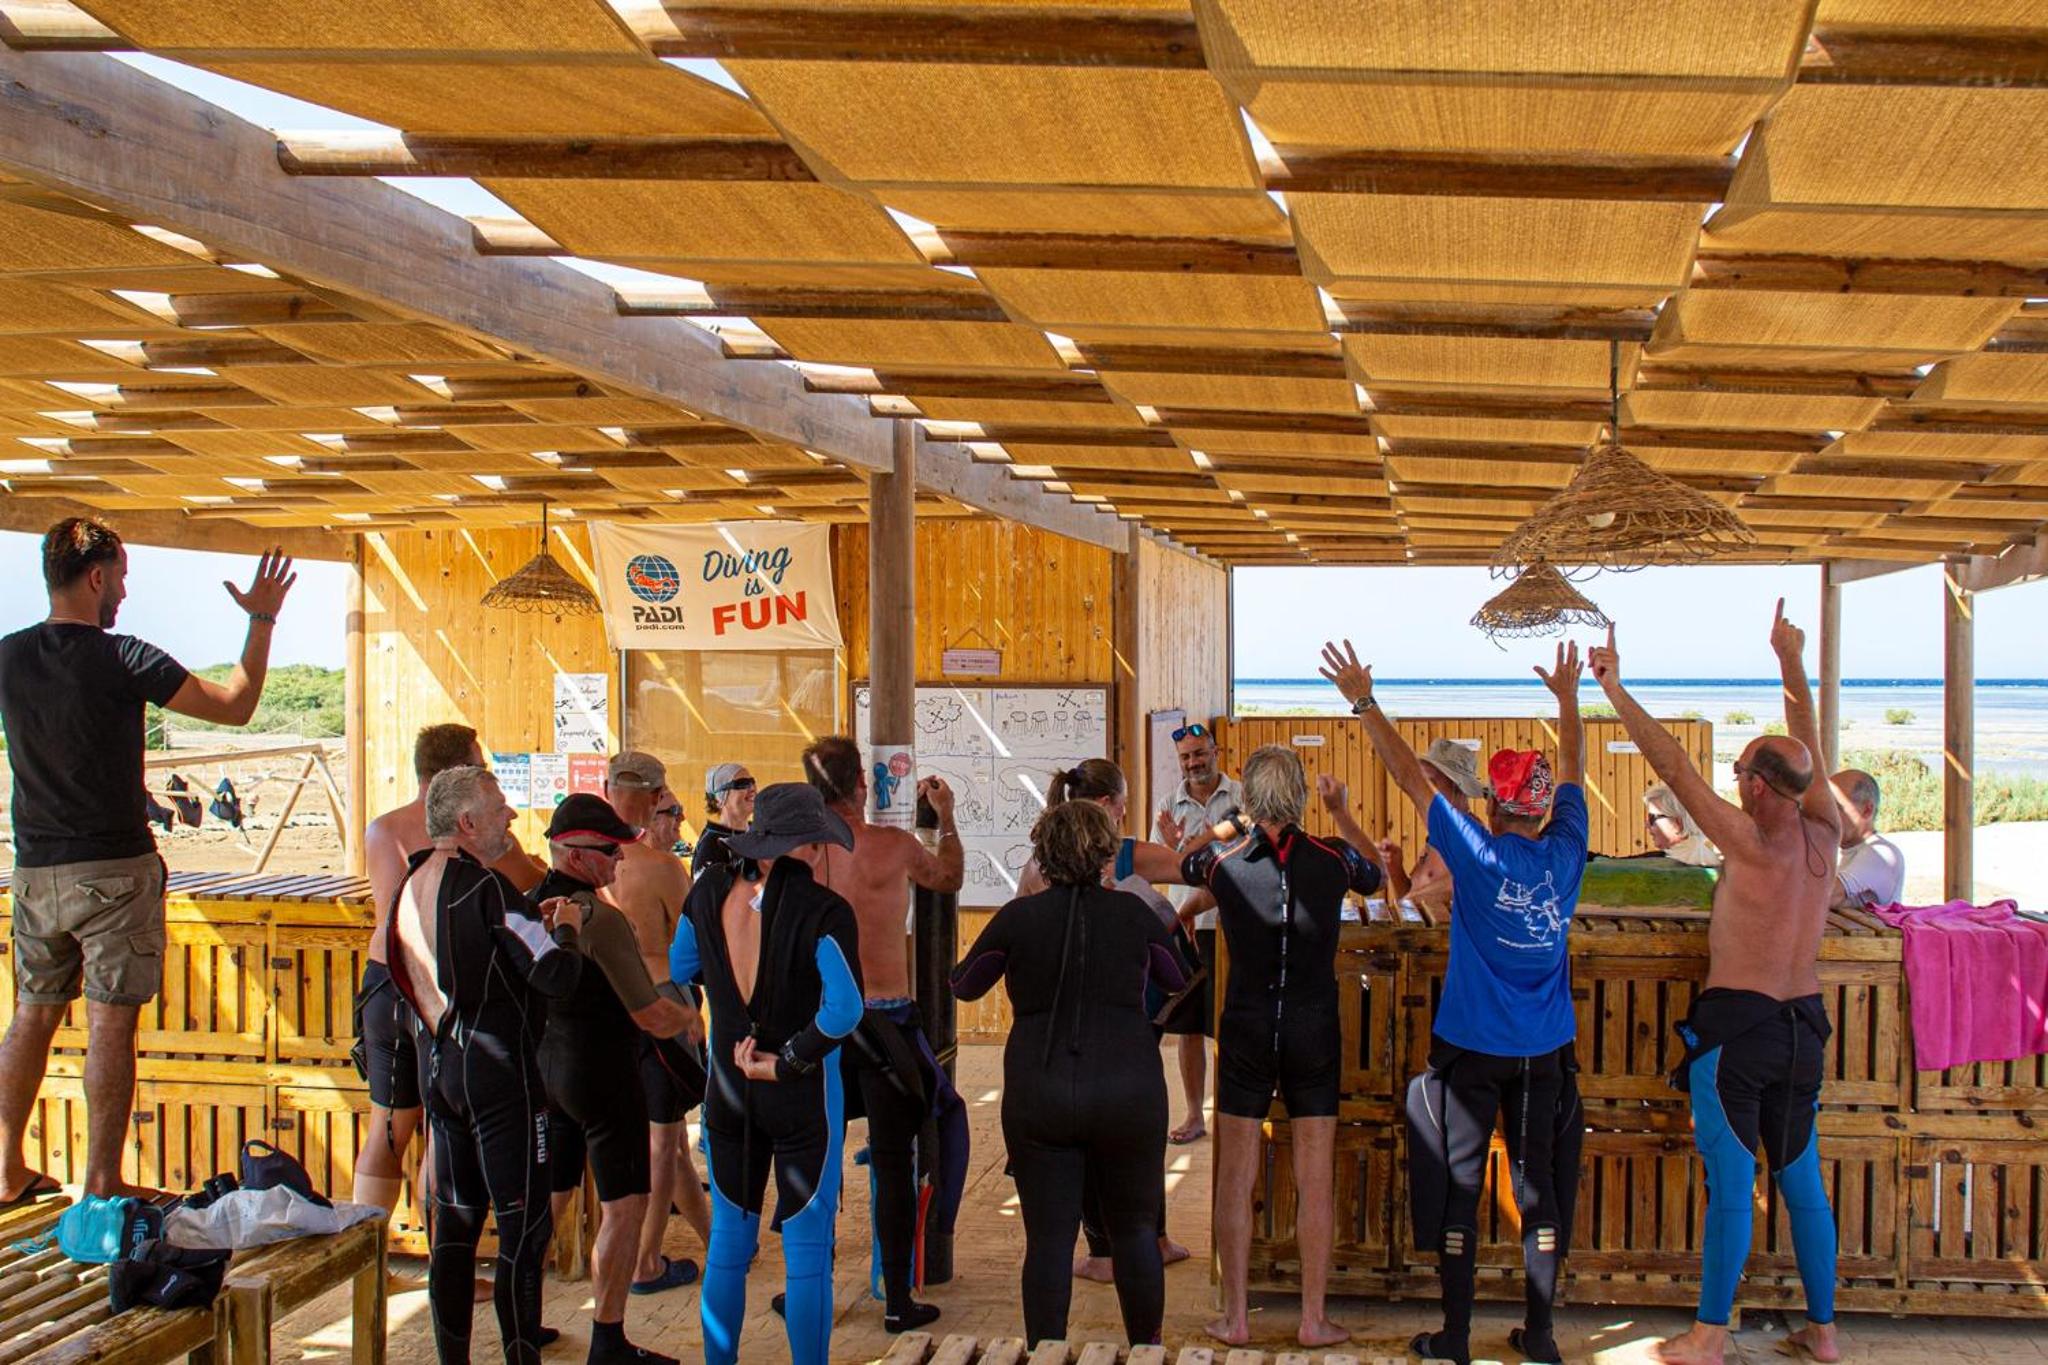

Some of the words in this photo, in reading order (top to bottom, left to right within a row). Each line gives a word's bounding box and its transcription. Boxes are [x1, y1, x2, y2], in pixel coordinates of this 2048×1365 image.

[703, 546, 792, 584] Diving
[744, 577, 764, 597] is
[632, 605, 684, 623] PADI
[635, 623, 686, 631] padi.com
[712, 591, 807, 635] FUN
[535, 1113, 546, 1163] mares
